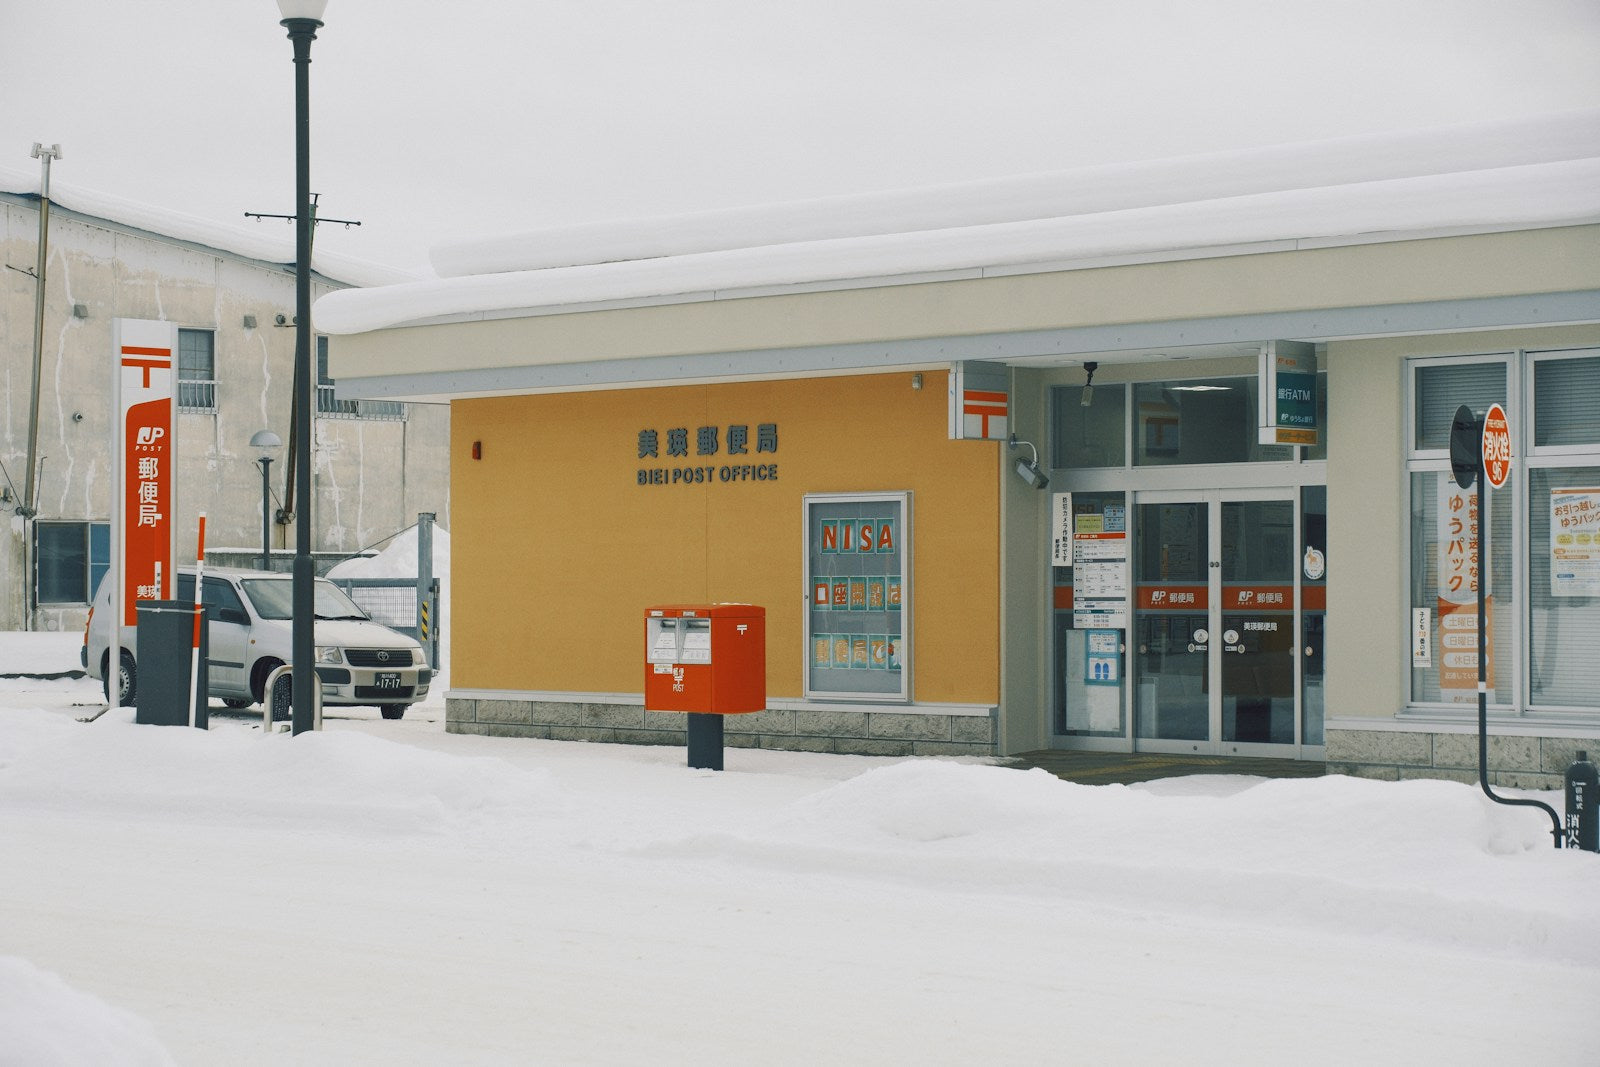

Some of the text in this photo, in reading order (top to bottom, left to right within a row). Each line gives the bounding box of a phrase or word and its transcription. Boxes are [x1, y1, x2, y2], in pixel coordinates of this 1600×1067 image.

[1278, 388, 1310, 401] 銀行ATM
[637, 423, 778, 459] 美瑛郵便局
[1485, 432, 1508, 460] 消火栓
[637, 464, 777, 485] BIEI POST OFFICE
[1492, 461, 1502, 480] 96
[138, 457, 159, 527] 郵便局
[1554, 501, 1600, 517] お引っ越し
[1560, 511, 1600, 527] ゆうパック
[823, 525, 893, 551] NISA
[1448, 495, 1464, 592] ゆうパック
[1469, 494, 1478, 592] 荷物を送るなら
[1170, 592, 1194, 603] 郵便局
[1256, 592, 1283, 604] 郵便局
[1243, 622, 1277, 631] 美瑛郵便局
[1449, 617, 1478, 627] 土曜日
[673, 683, 684, 692] POST
